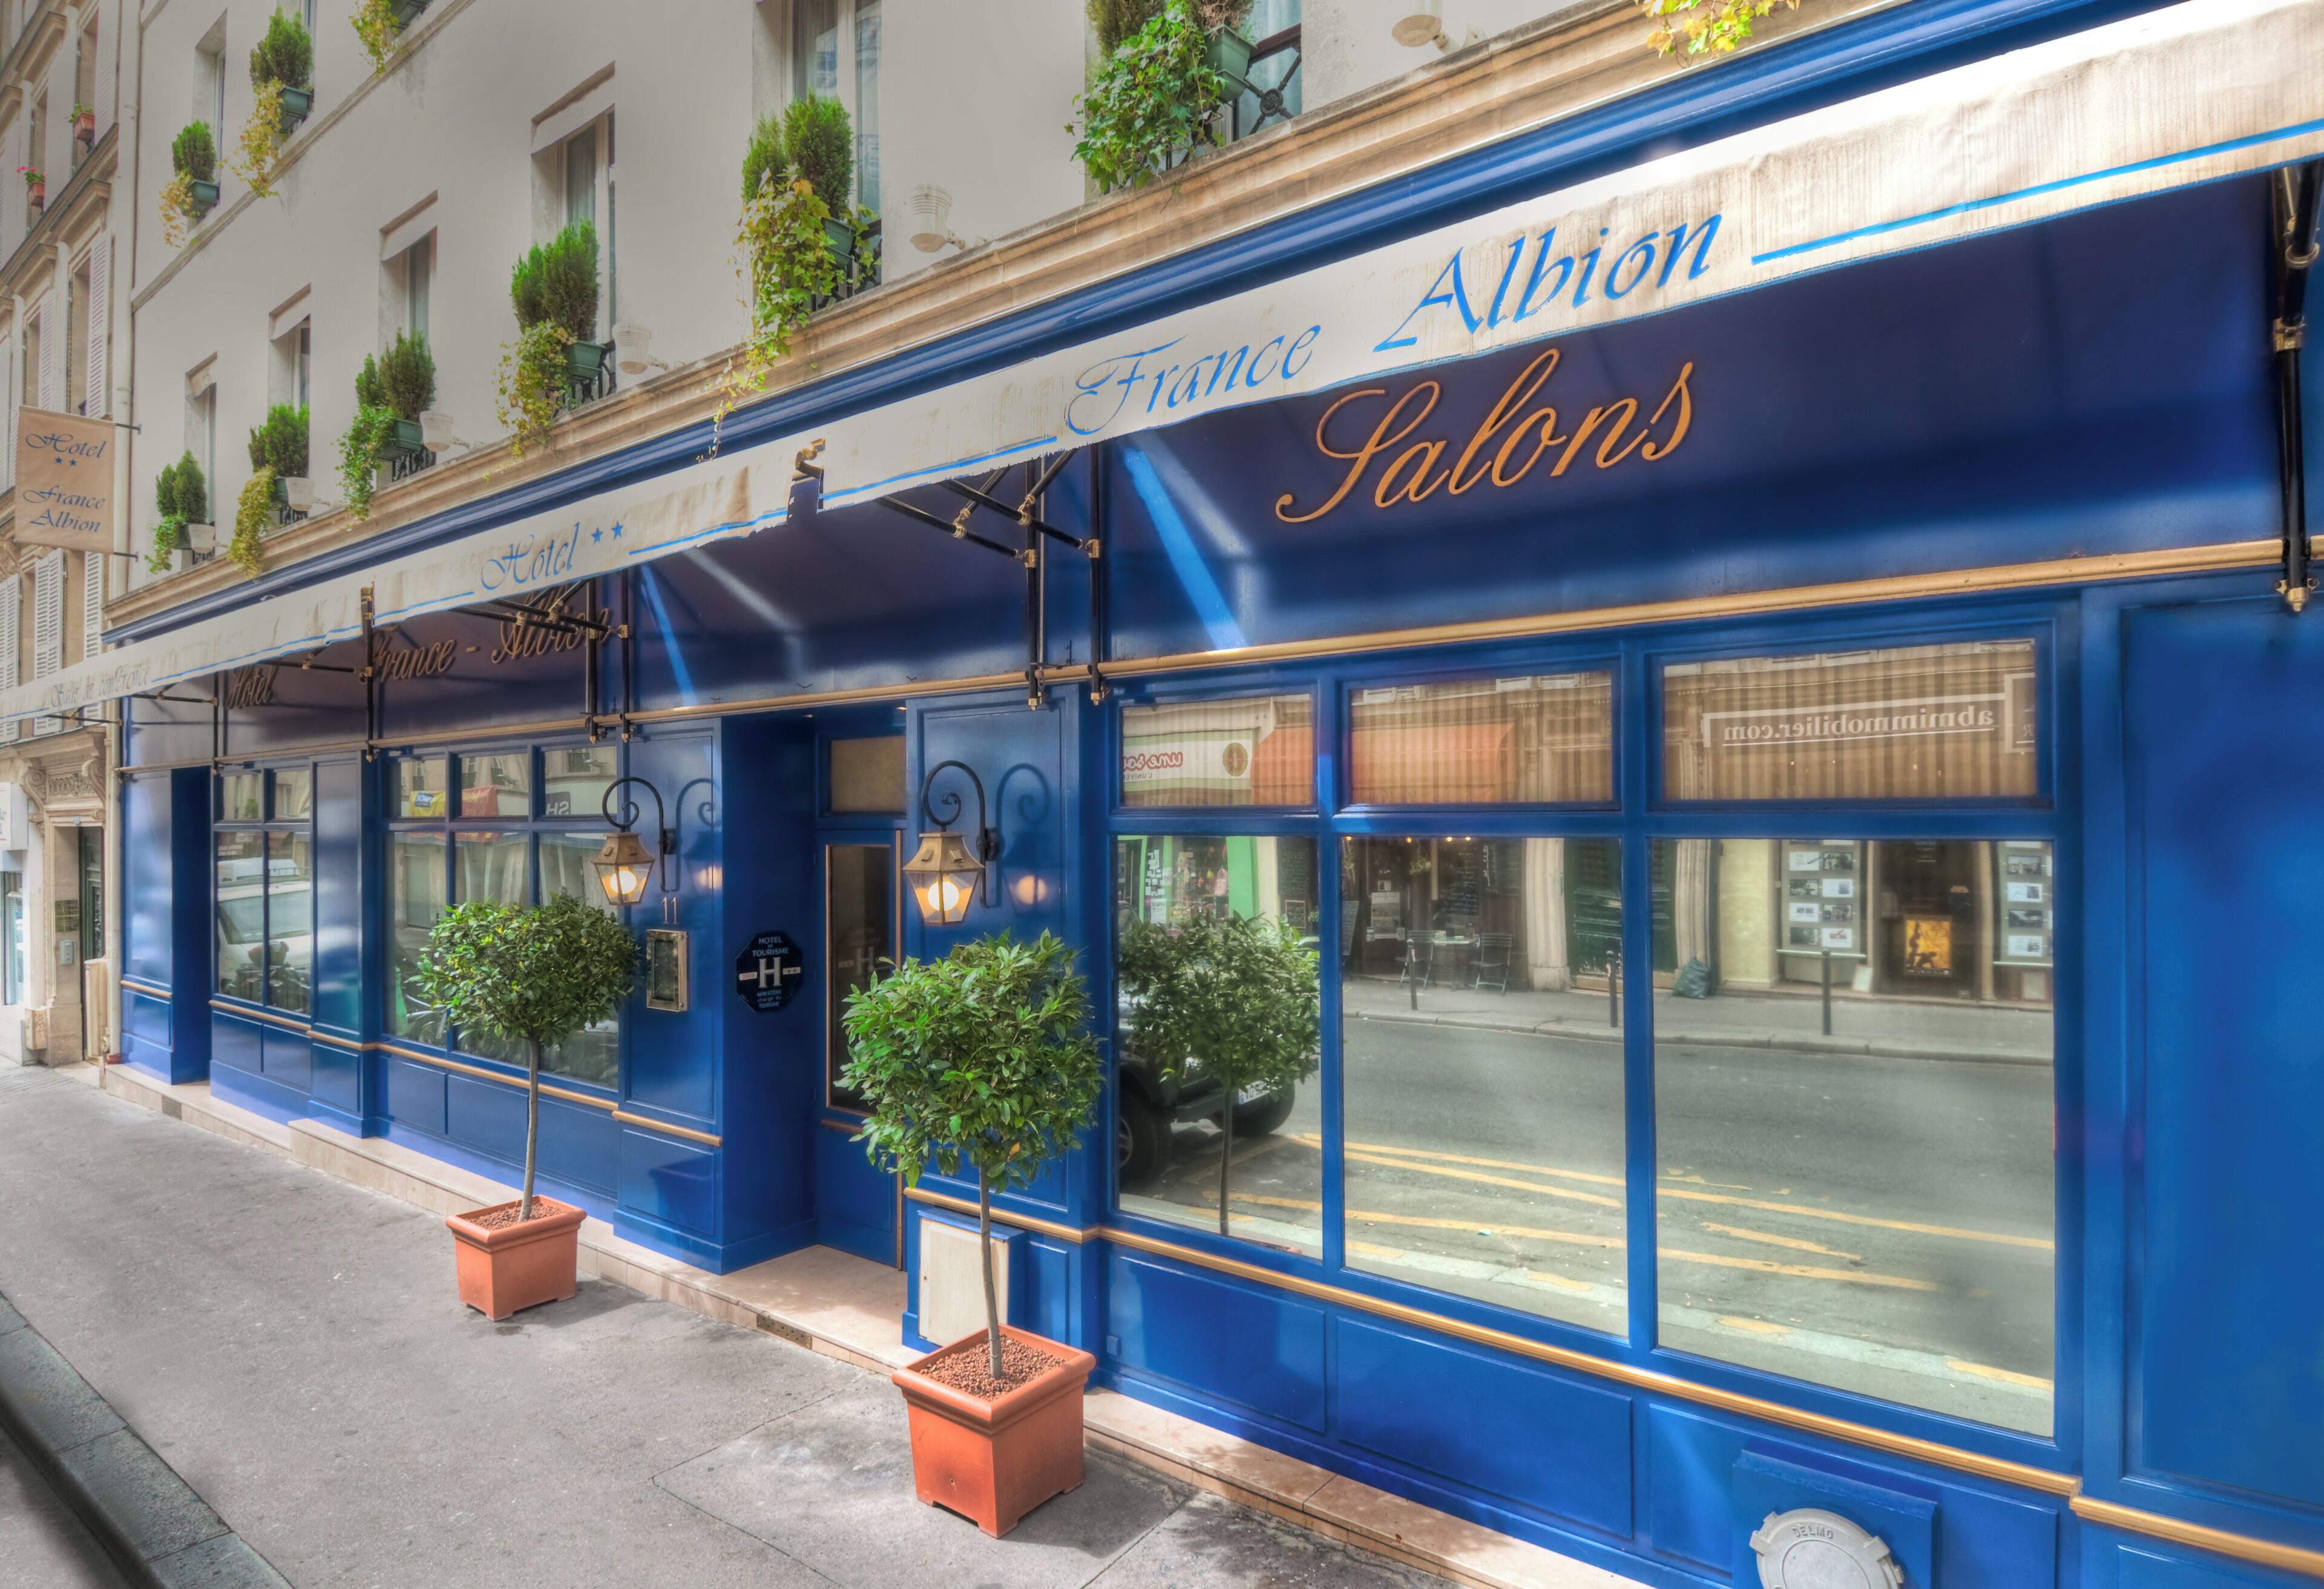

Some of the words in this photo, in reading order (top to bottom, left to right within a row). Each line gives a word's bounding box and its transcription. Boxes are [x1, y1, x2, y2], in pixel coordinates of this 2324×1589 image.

[1065, 325, 1321, 435] France
[1372, 214, 1722, 352] Albion
[25, 433, 107, 458] Hotel
[1275, 349, 1693, 523] Salons
[23, 485, 105, 509] France
[30, 508, 101, 533] Albion
[481, 521, 580, 591] Hotel
[752, 947, 789, 957] TOURISME
[1792, 1524, 1834, 1540] DELMO
